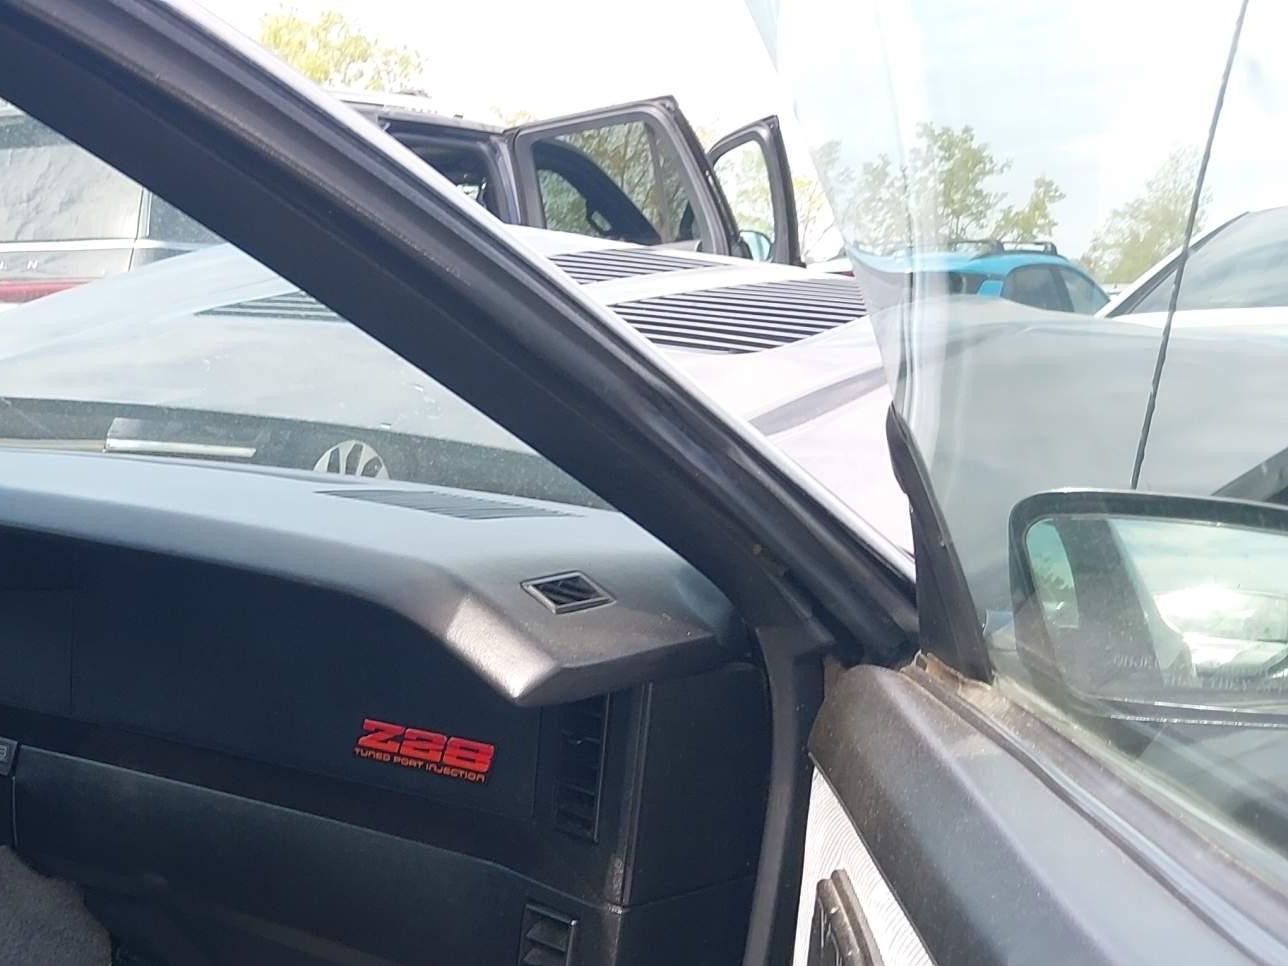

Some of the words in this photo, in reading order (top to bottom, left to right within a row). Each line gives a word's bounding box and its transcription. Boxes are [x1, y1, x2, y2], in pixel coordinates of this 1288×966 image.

[354, 747, 391, 761] TUNED
[393, 756, 424, 769] PORT
[426, 763, 485, 782] INJECTION
[357, 718, 495, 773] Z28
